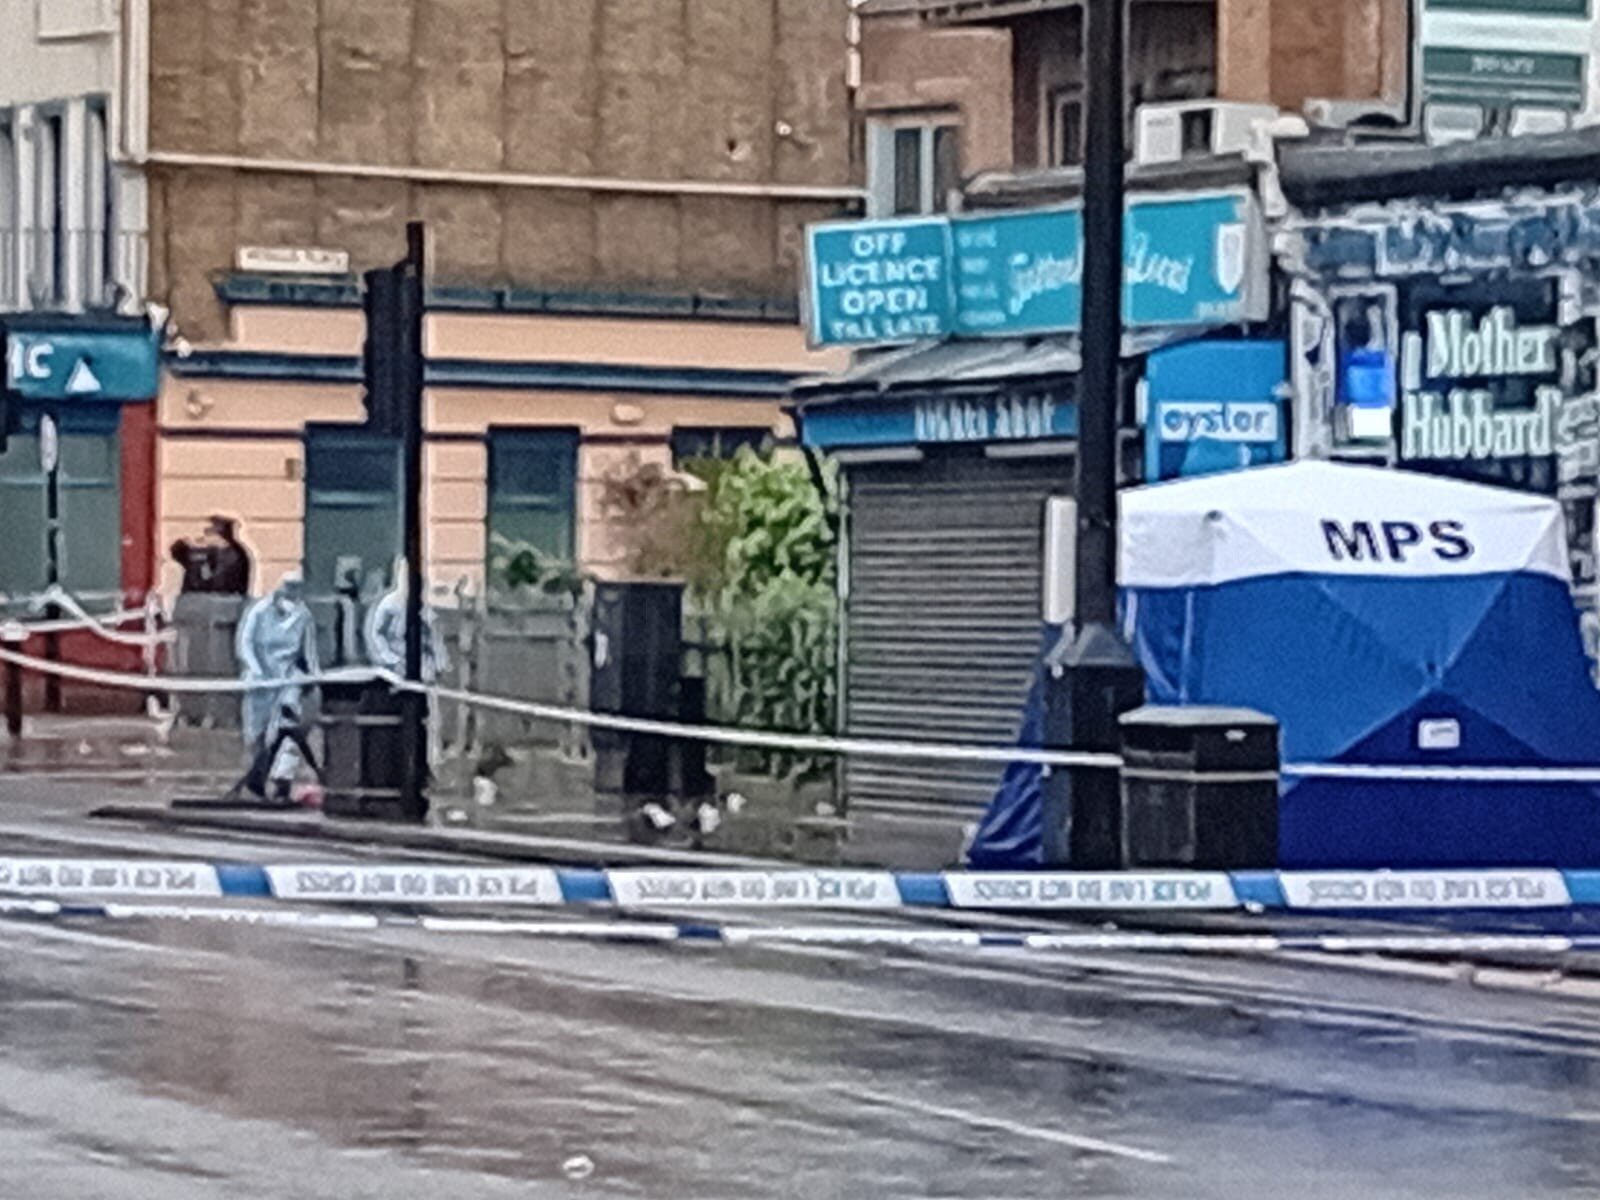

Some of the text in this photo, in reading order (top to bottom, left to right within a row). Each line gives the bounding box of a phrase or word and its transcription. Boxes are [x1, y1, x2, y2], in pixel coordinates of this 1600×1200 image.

[854, 232, 905, 256] OFF
[822, 255, 941, 286] LICENCE
[842, 284, 927, 314] OPEN
[1426, 307, 1556, 378] Mother
[1163, 402, 1270, 439] oyster
[1402, 387, 1556, 459] Hubbard
[1320, 519, 1475, 561] MPS
